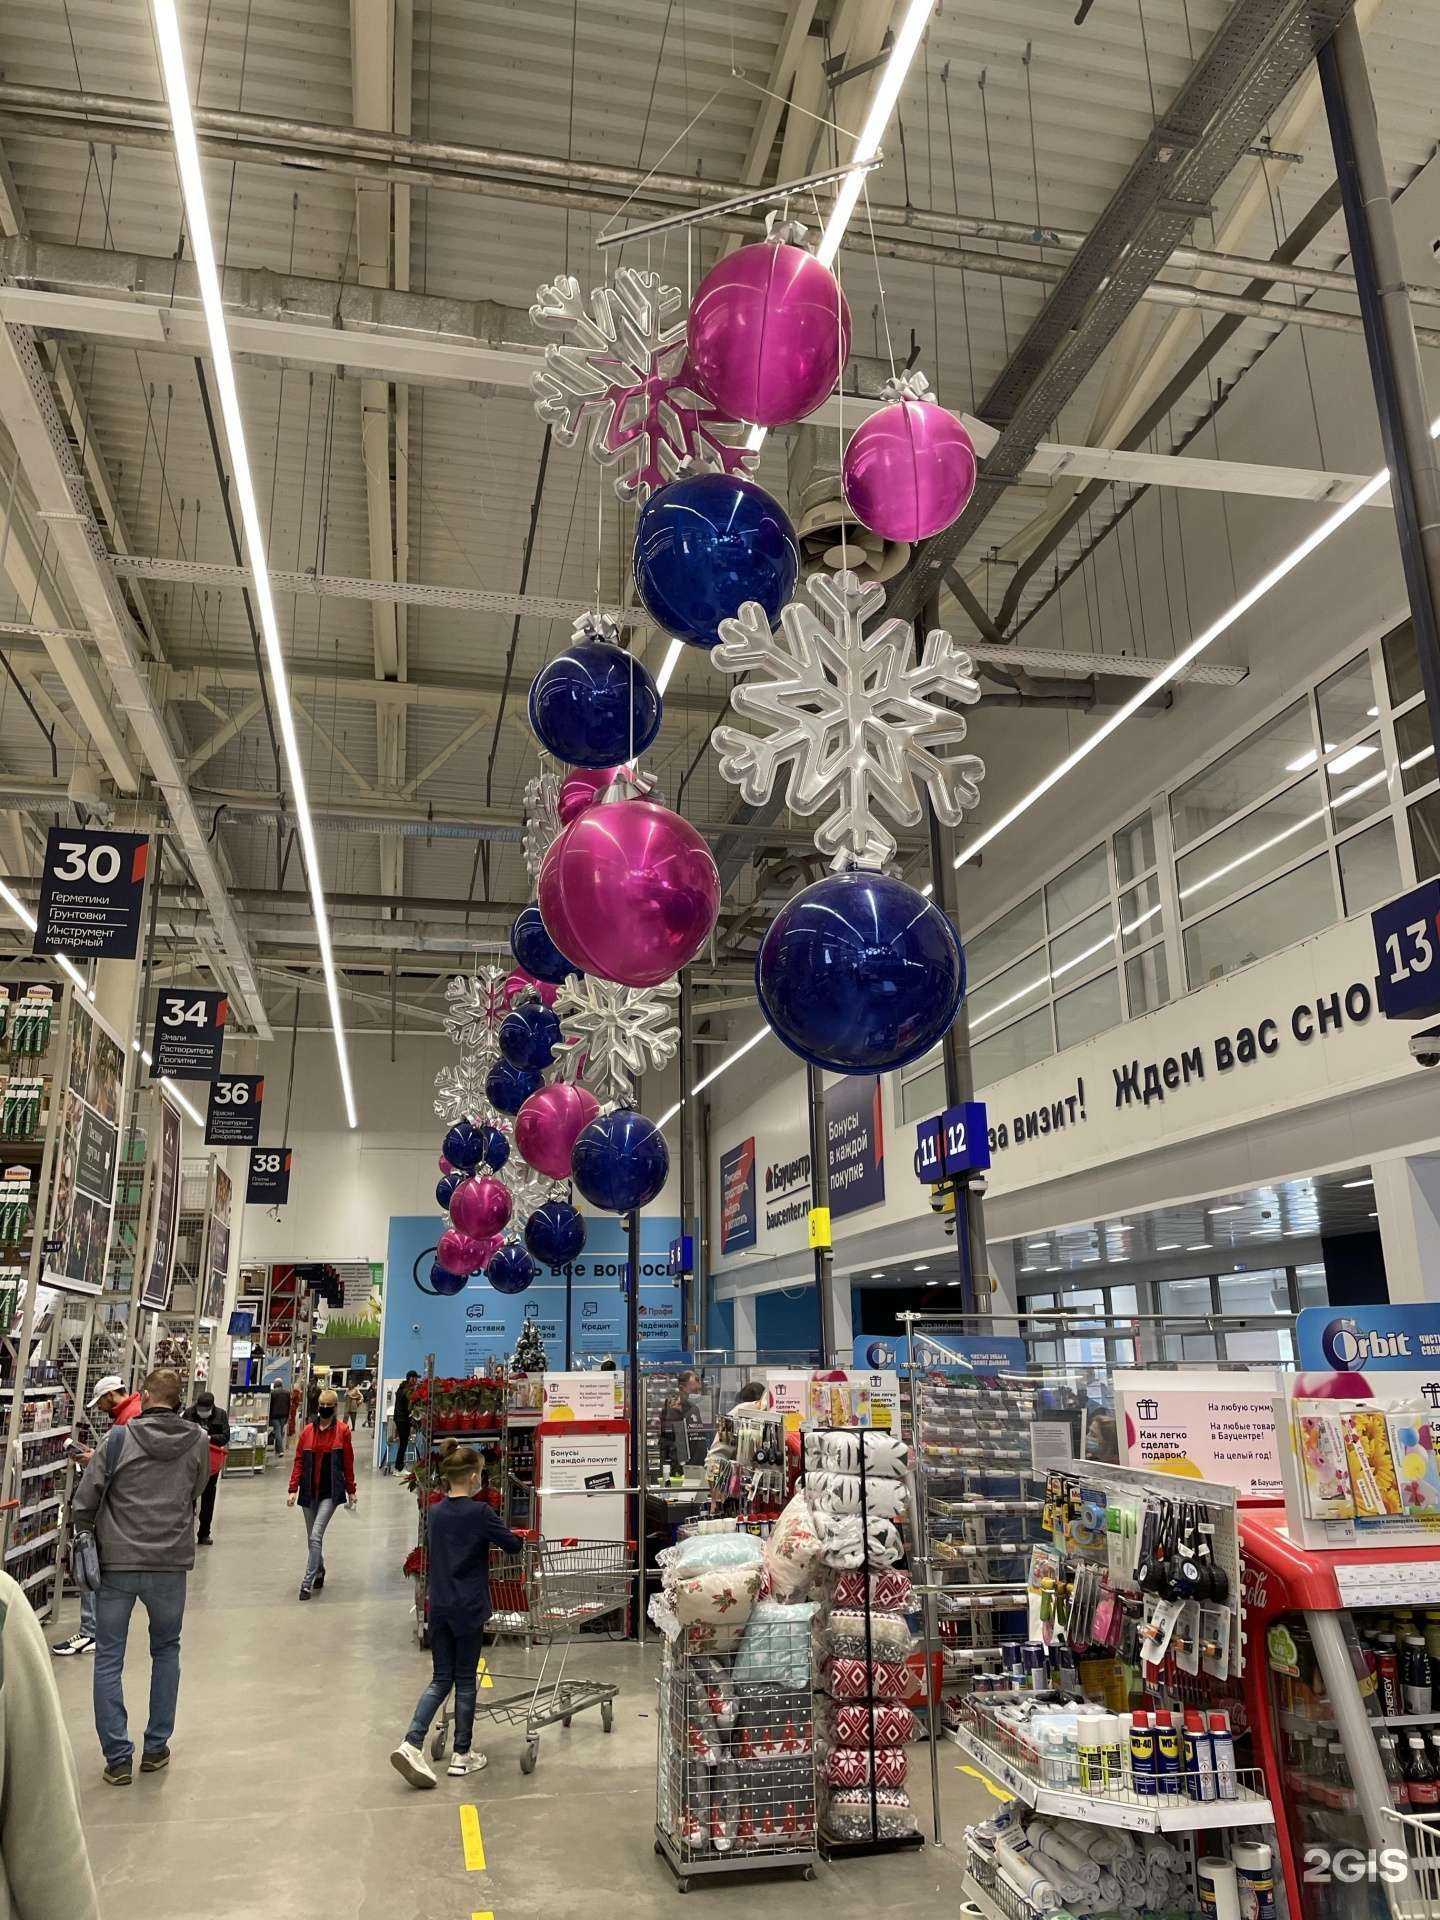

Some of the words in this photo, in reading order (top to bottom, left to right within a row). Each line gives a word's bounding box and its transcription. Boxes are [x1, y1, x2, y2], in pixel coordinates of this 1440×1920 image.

[53, 842, 121, 883] 30
[51, 891, 110, 905] Герметики
[49, 908, 106, 921] Грунтовки
[47, 924, 115, 938] Инструмент
[45, 937, 104, 948] малярный
[1385, 919, 1433, 984] 13
[162, 998, 208, 1028] 34
[160, 1033, 187, 1041] Эмали
[159, 1044, 214, 1055] Растворители
[158, 1055, 197, 1065] Пропитки
[157, 1066, 177, 1075] Лаки
[1014, 1077, 1088, 1143] визит!
[1113, 1046, 1205, 1108] Ждем
[1214, 1018, 1279, 1072] вас
[214, 1082, 249, 1105] 36
[828, 1111, 859, 1141] Бонусы
[948, 1122, 967, 1156] 12
[829, 1150, 835, 1166] в
[835, 1128, 868, 1160] каждой
[921, 1135, 937, 1167] 11
[252, 1154, 280, 1172] 38
[773, 1154, 811, 1192] Бауцентр
[830, 1162, 864, 1190] покупке
[766, 1199, 811, 1230] baucenter.ru
[465, 1324, 506, 1334] Доставка
[581, 1323, 611, 1332] Кредит
[1332, 1329, 1412, 1362] Orbit
[1207, 1402, 1219, 1411] На
[1220, 1402, 1249, 1413] любую
[1210, 1422, 1221, 1431] На
[1222, 1422, 1251, 1431] любые
[1139, 1430, 1157, 1440] Как
[1159, 1431, 1188, 1440] легко
[1218, 1431, 1265, 1442] Бауцентре!
[1140, 1441, 1180, 1450] сделать
[550, 1449, 579, 1457] Бонусы
[1141, 1450, 1187, 1460] подарок?
[1213, 1451, 1225, 1460] На
[1226, 1450, 1254, 1461] целый
[1255, 1451, 1272, 1461] год!
[1383, 1676, 1395, 1717] ENERGY
[1131, 1738, 1152, 1749] WD-40
